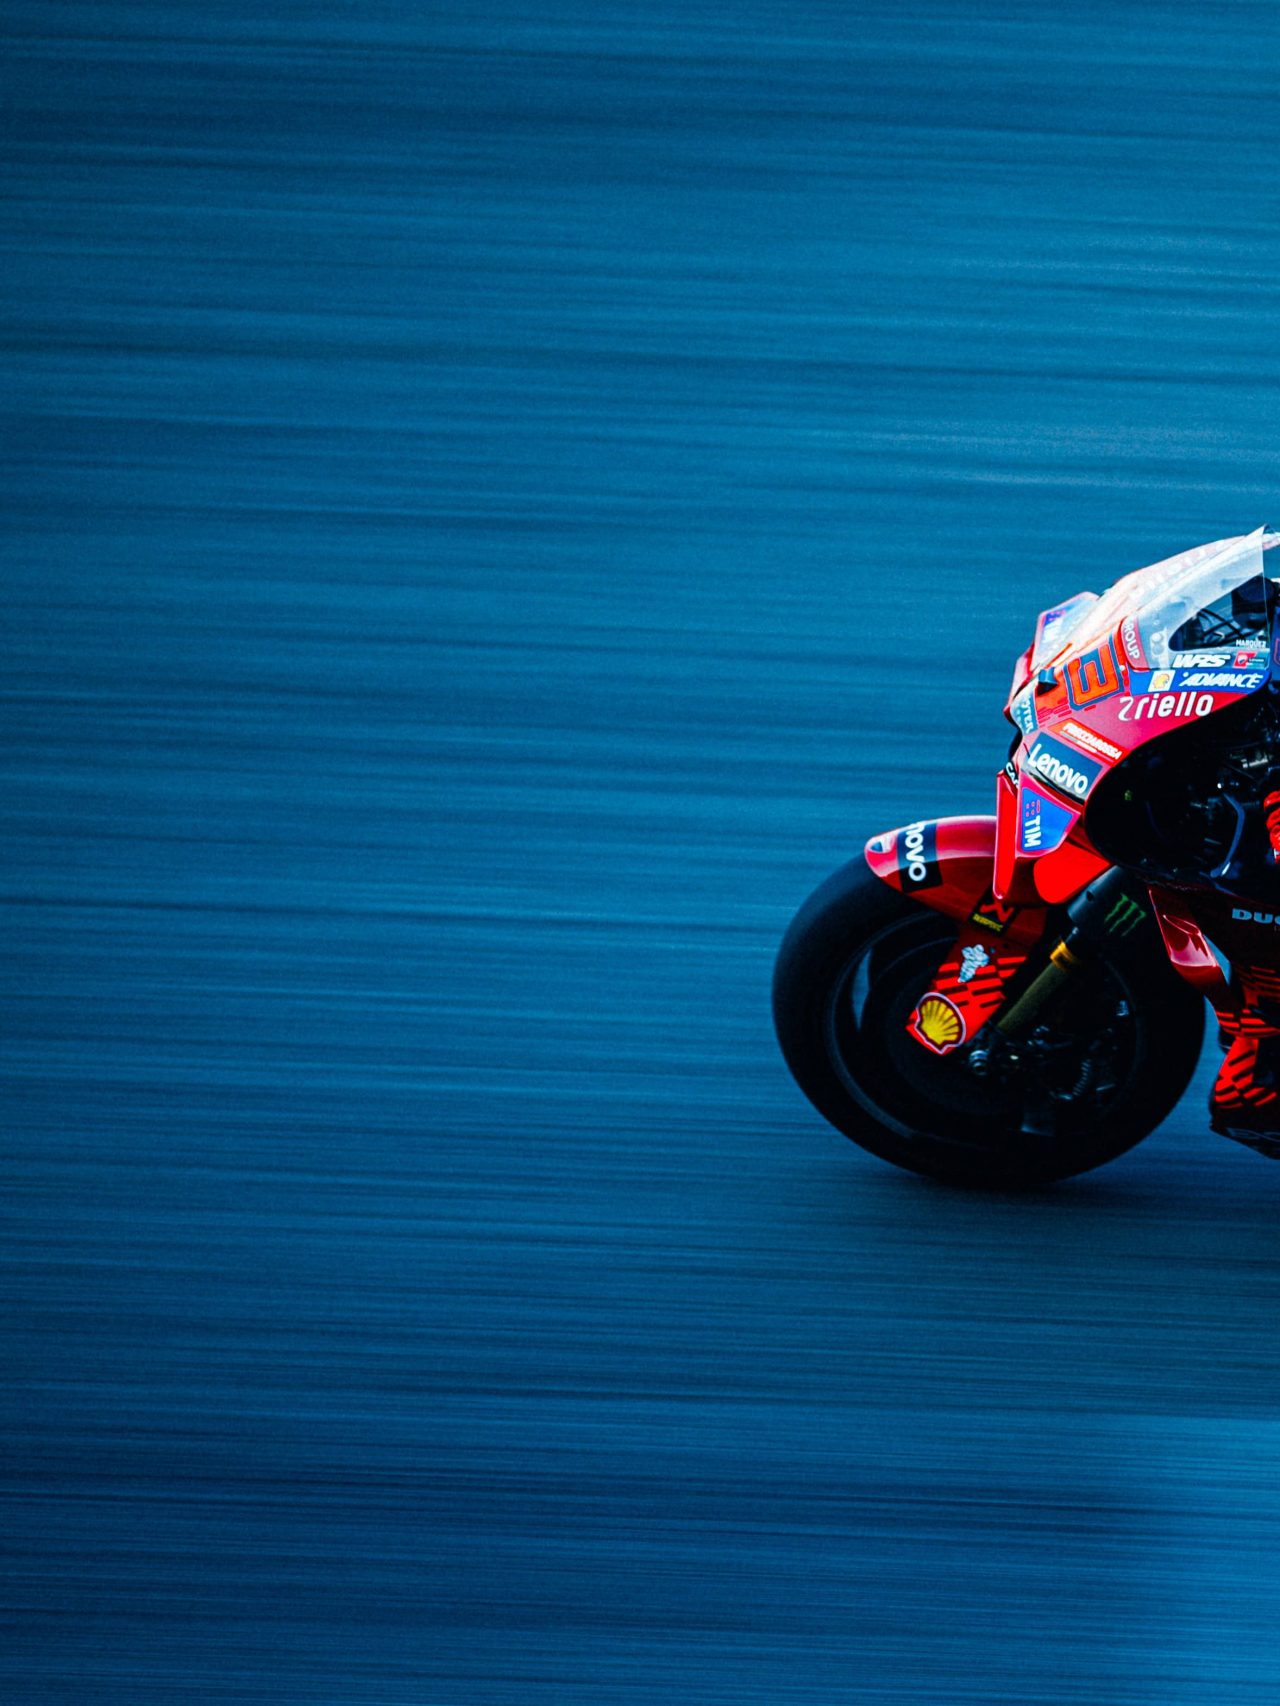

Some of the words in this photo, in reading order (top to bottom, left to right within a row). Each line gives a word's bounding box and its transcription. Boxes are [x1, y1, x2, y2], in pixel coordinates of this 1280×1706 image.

[1179, 672, 1263, 688] ADVANCE
[1134, 691, 1214, 720] riello
[1027, 743, 1089, 794] Lenovo
[1024, 815, 1042, 848] TIM
